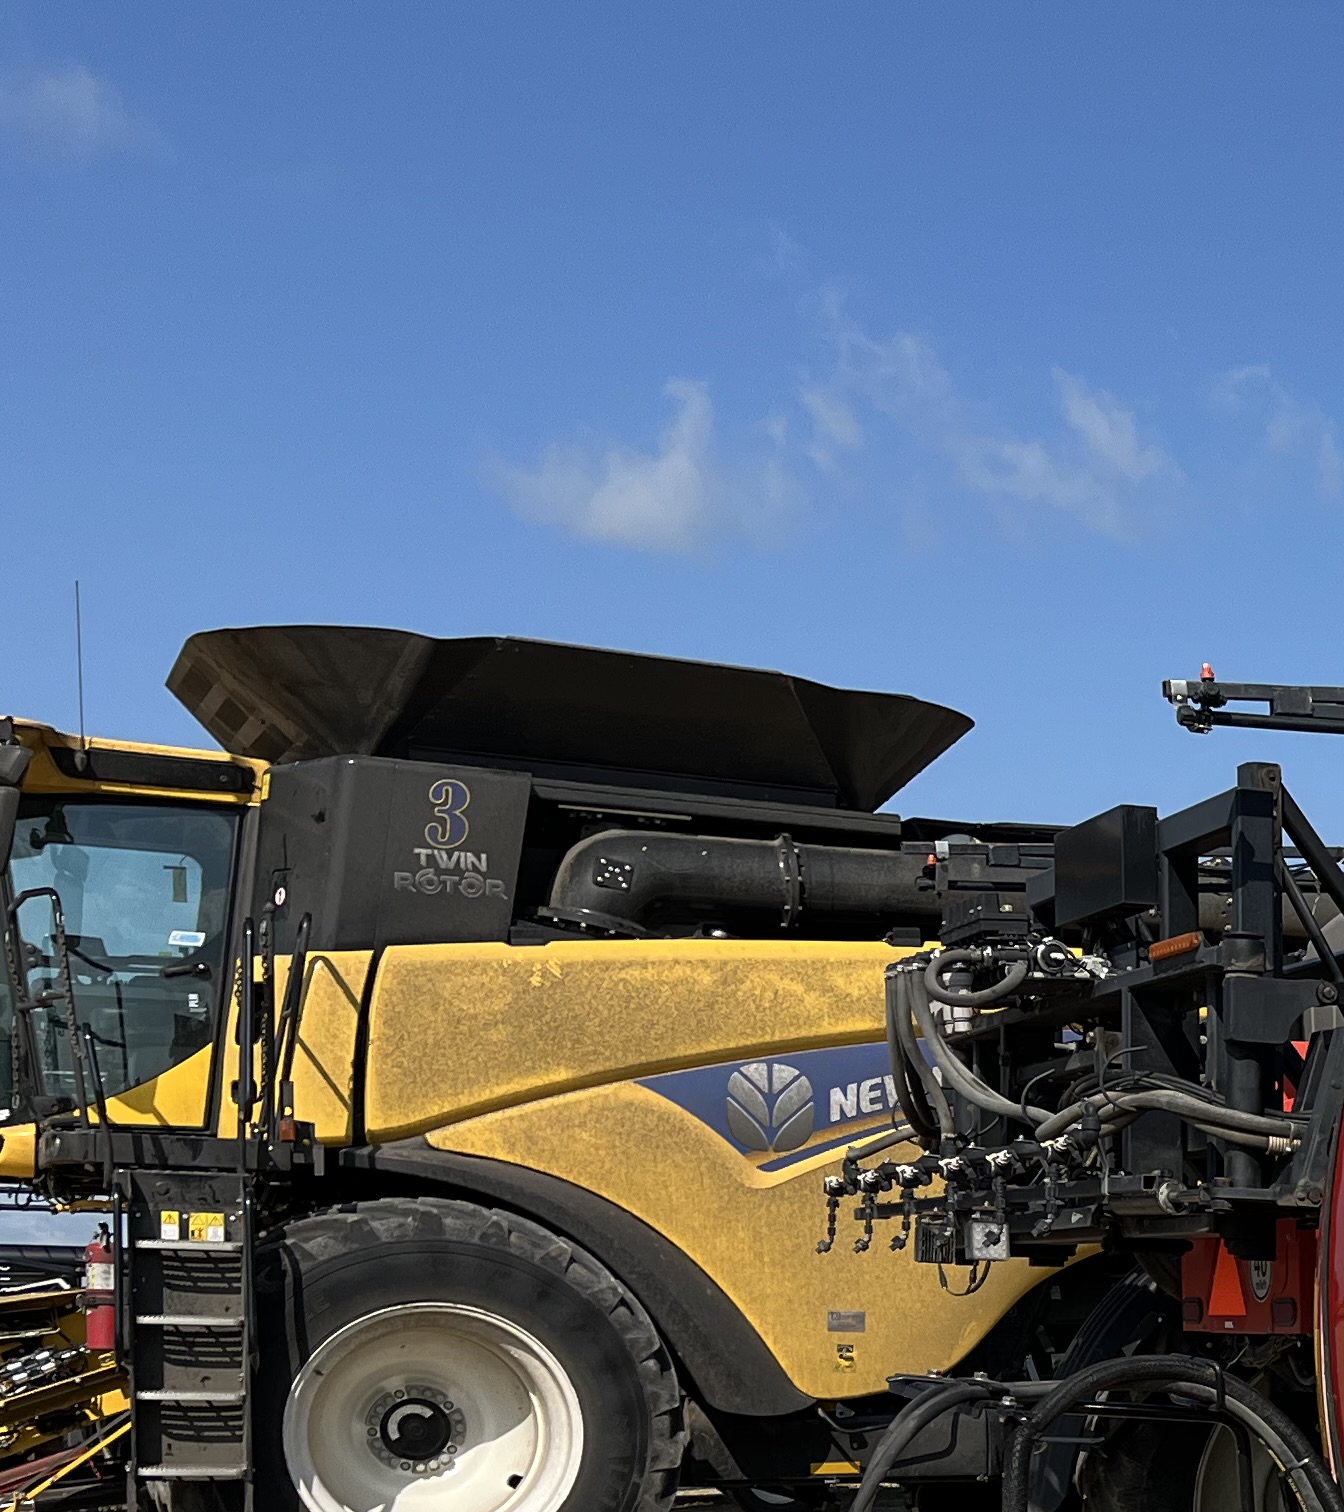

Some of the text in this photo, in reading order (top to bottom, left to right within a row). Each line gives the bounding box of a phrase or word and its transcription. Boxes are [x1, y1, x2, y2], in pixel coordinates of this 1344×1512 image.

[425, 779, 471, 849] 3
[413, 848, 488, 872] TWIN
[394, 868, 508, 900] ROTOR
